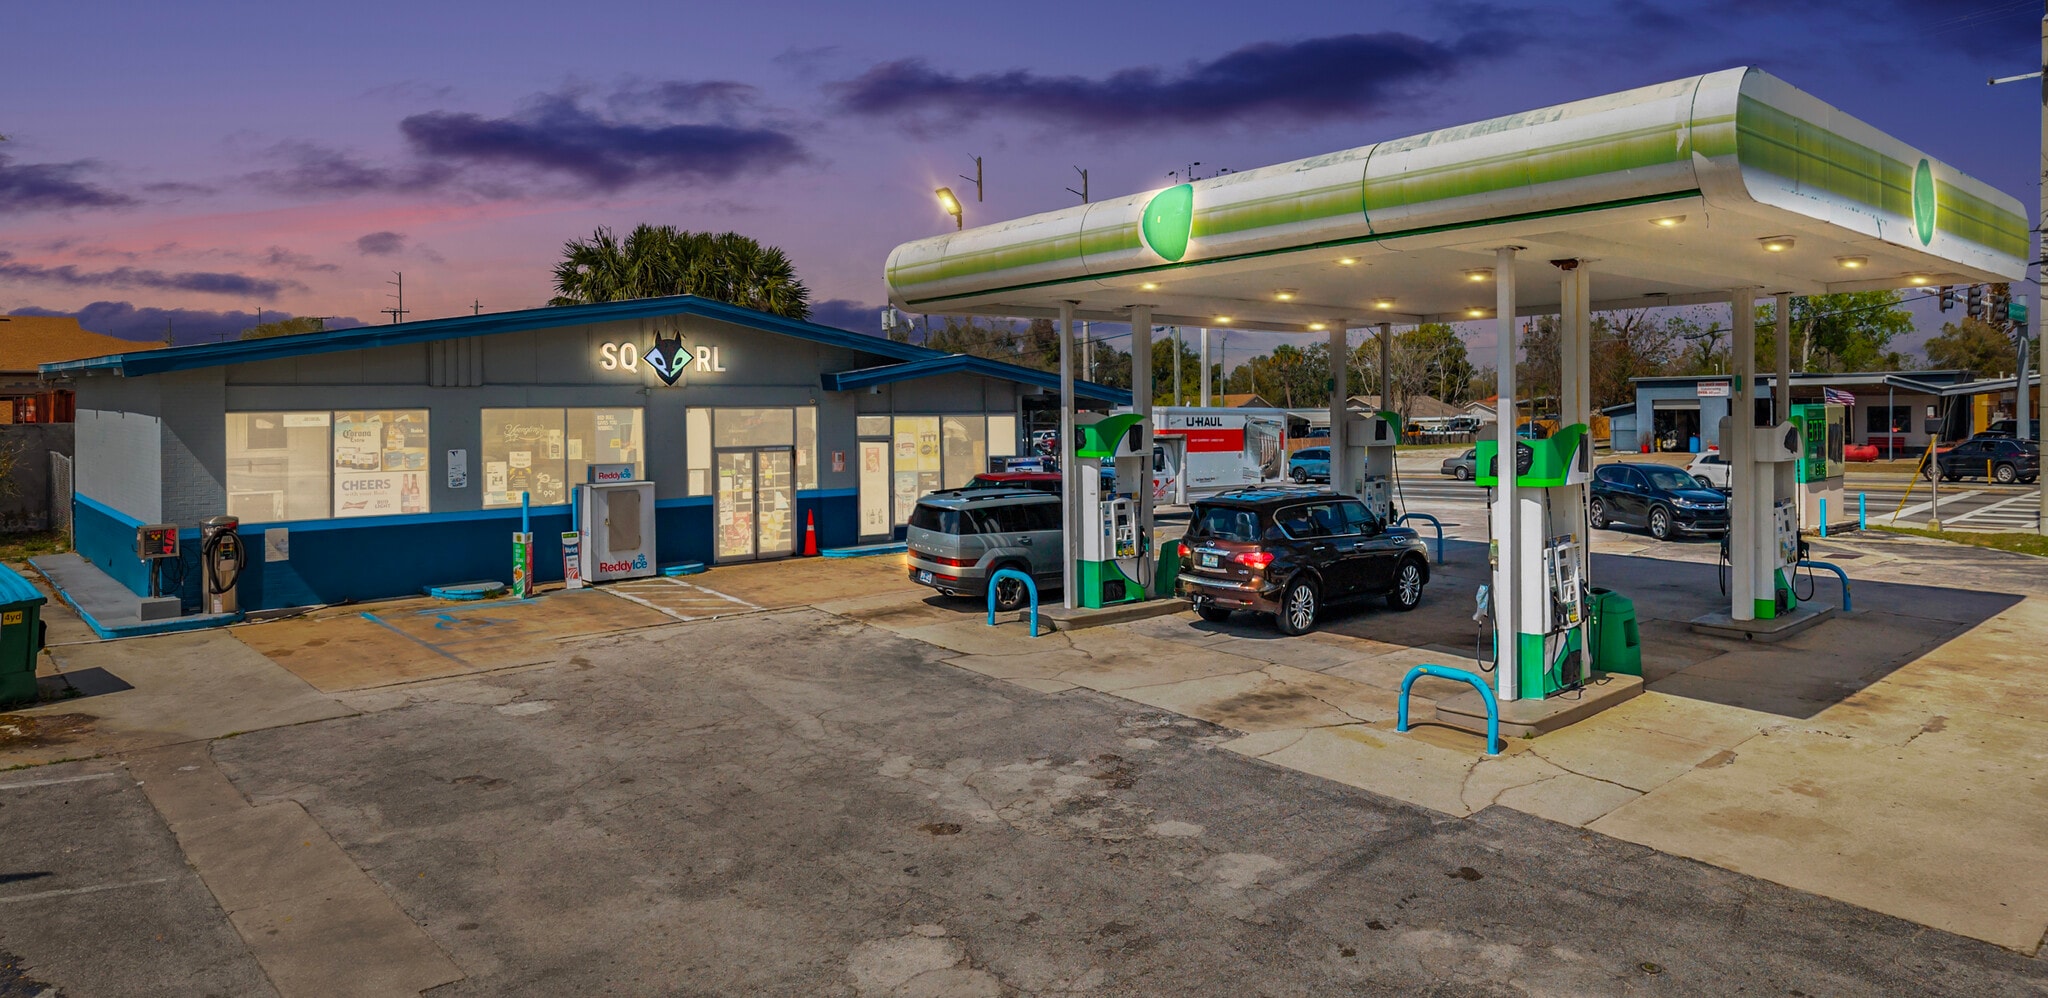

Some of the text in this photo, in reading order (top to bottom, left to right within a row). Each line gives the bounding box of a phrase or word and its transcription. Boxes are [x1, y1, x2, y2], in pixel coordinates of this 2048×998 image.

[1186, 416, 1223, 427] U-HAUL
[342, 429, 372, 439] Corona
[341, 479, 391, 491] CHEERS
[4, 613, 21, 622] 4yd
